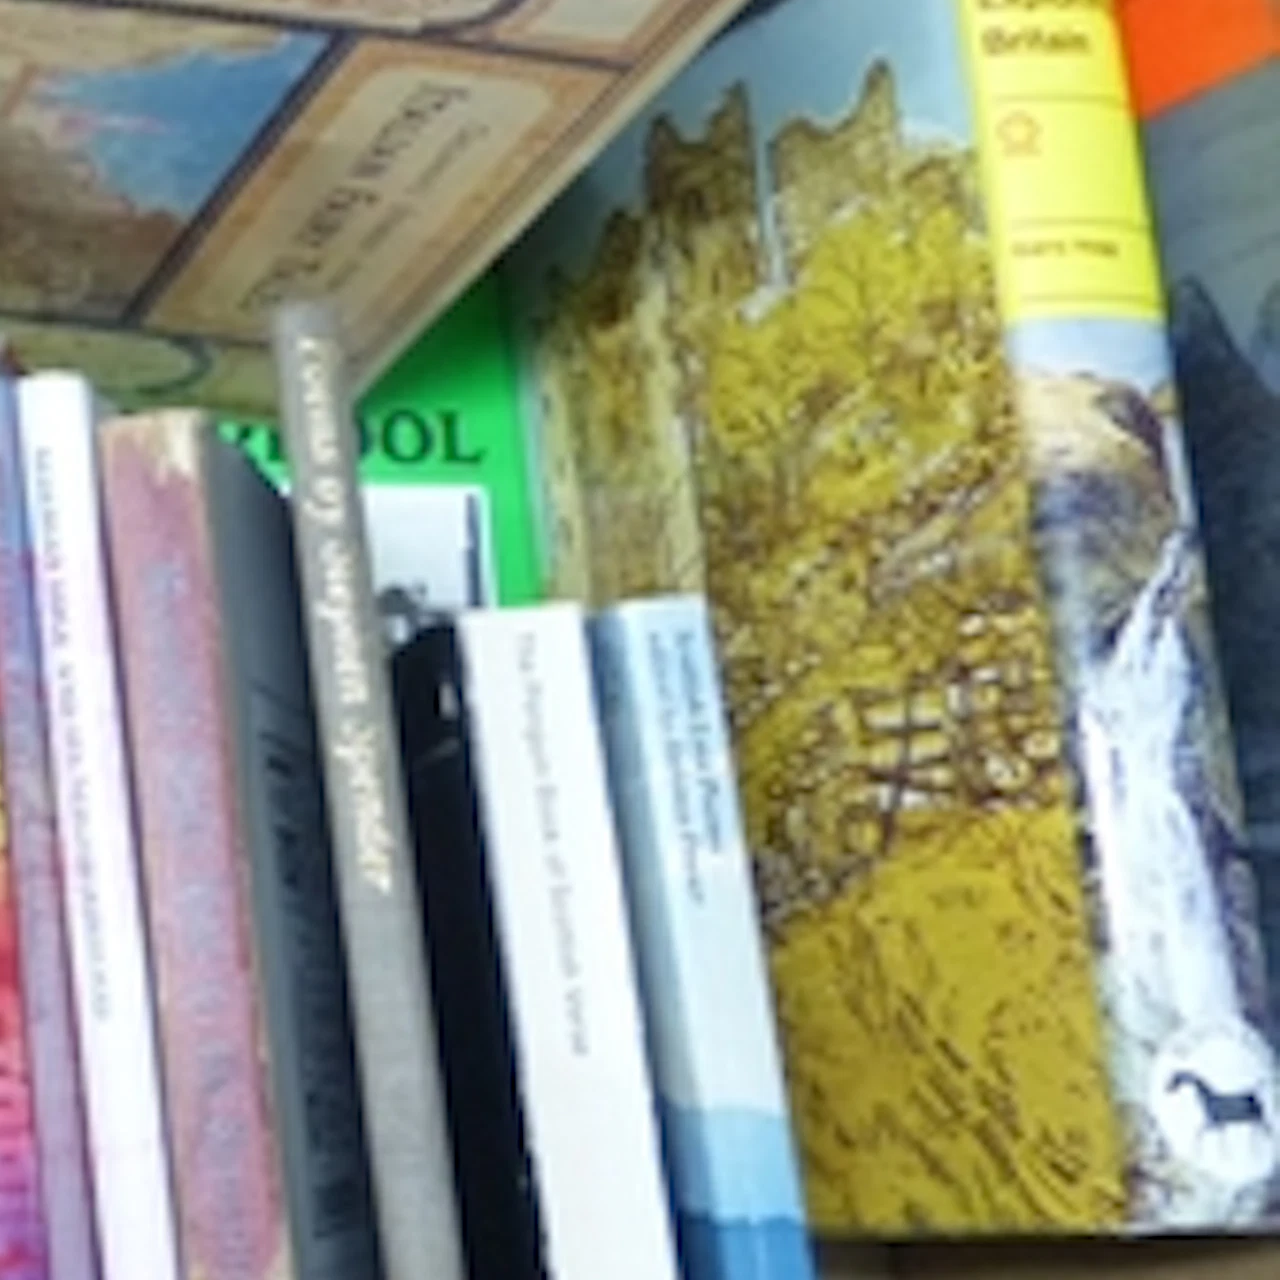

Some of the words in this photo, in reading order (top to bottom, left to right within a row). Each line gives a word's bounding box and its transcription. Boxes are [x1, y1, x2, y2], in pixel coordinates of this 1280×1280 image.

[295, 333, 340, 466] Poems
[304, 475, 346, 526] by
[308, 538, 370, 709] Stephen
[337, 719, 395, 897] Spender
